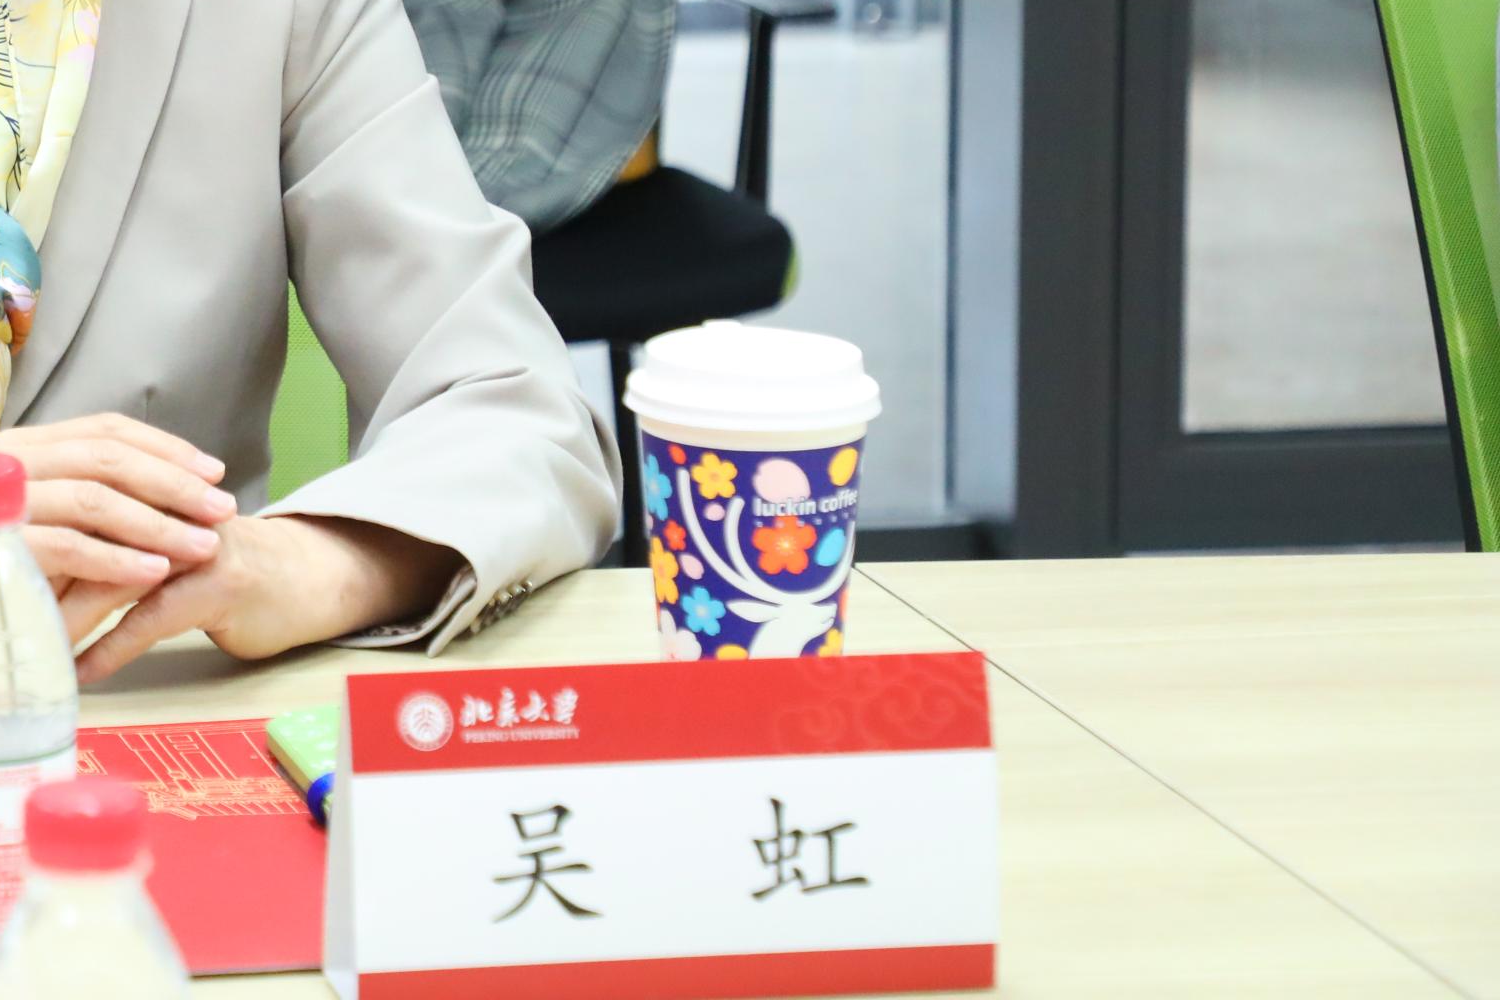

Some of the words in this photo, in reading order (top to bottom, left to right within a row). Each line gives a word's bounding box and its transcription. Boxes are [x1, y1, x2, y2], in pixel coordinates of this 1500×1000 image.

[754, 497, 817, 517] luckin
[493, 803, 604, 923] 吴
[750, 797, 871, 901] 虹
